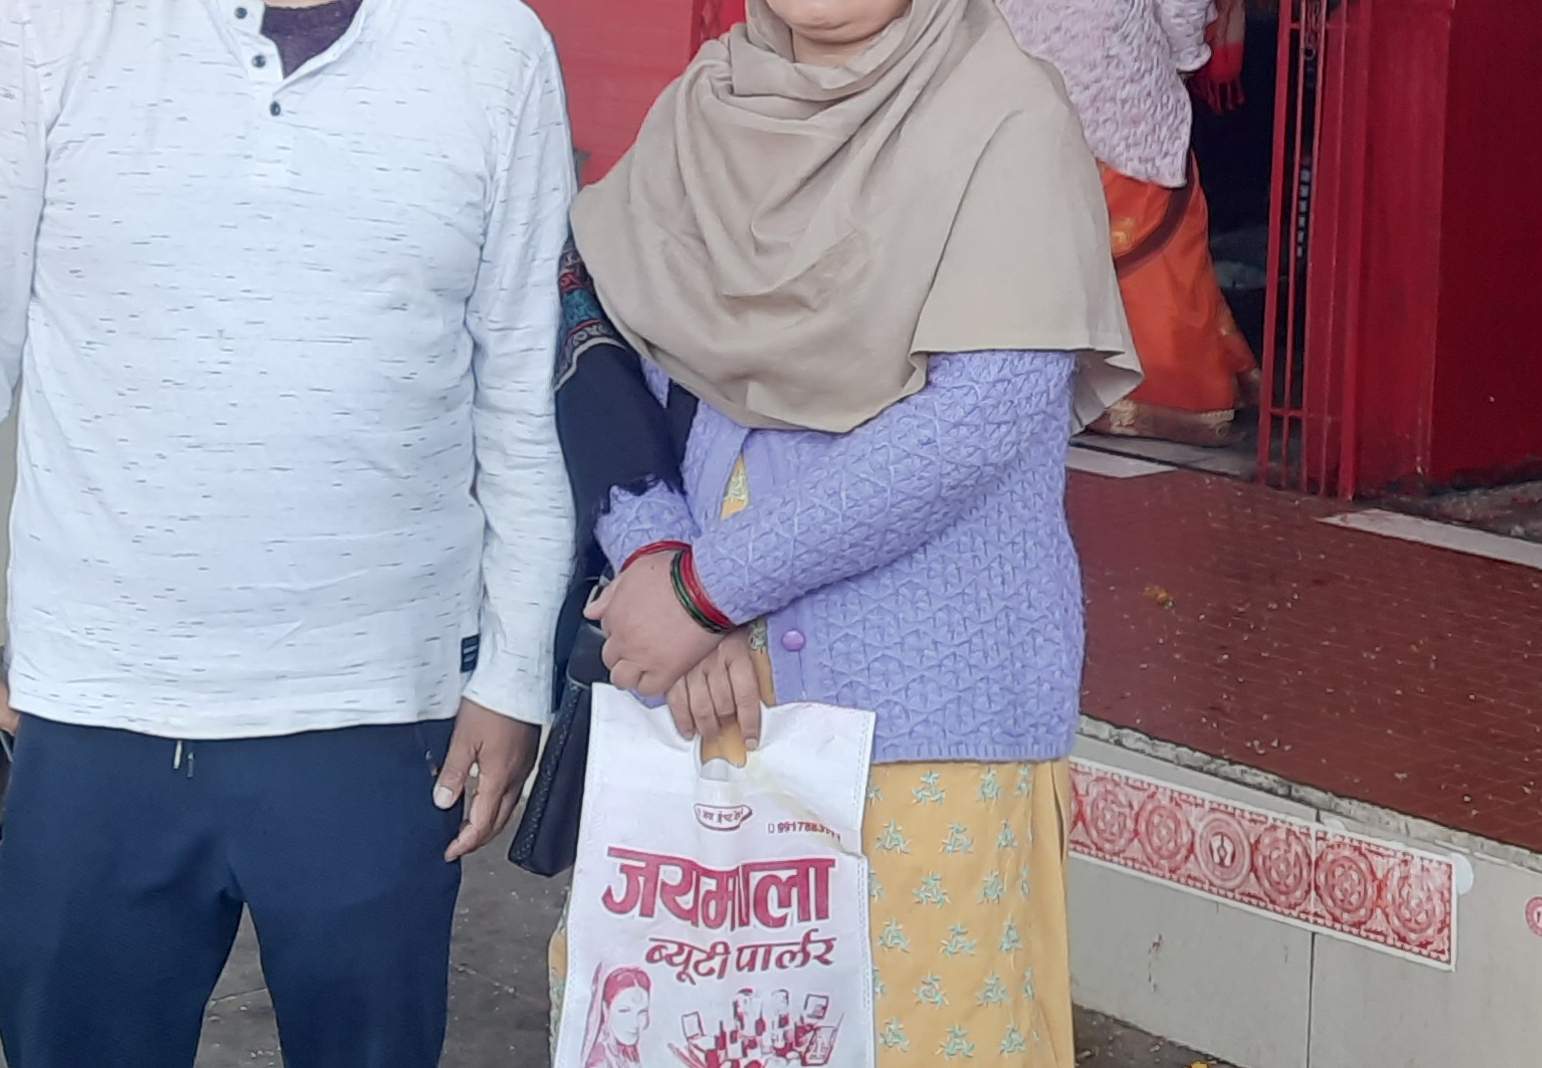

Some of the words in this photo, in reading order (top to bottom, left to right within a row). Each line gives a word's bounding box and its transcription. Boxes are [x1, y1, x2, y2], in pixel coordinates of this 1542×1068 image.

[601, 845, 836, 932] जयमाला
[645, 936, 731, 985] ब्यूटी
[735, 928, 837, 973] पार्लर
